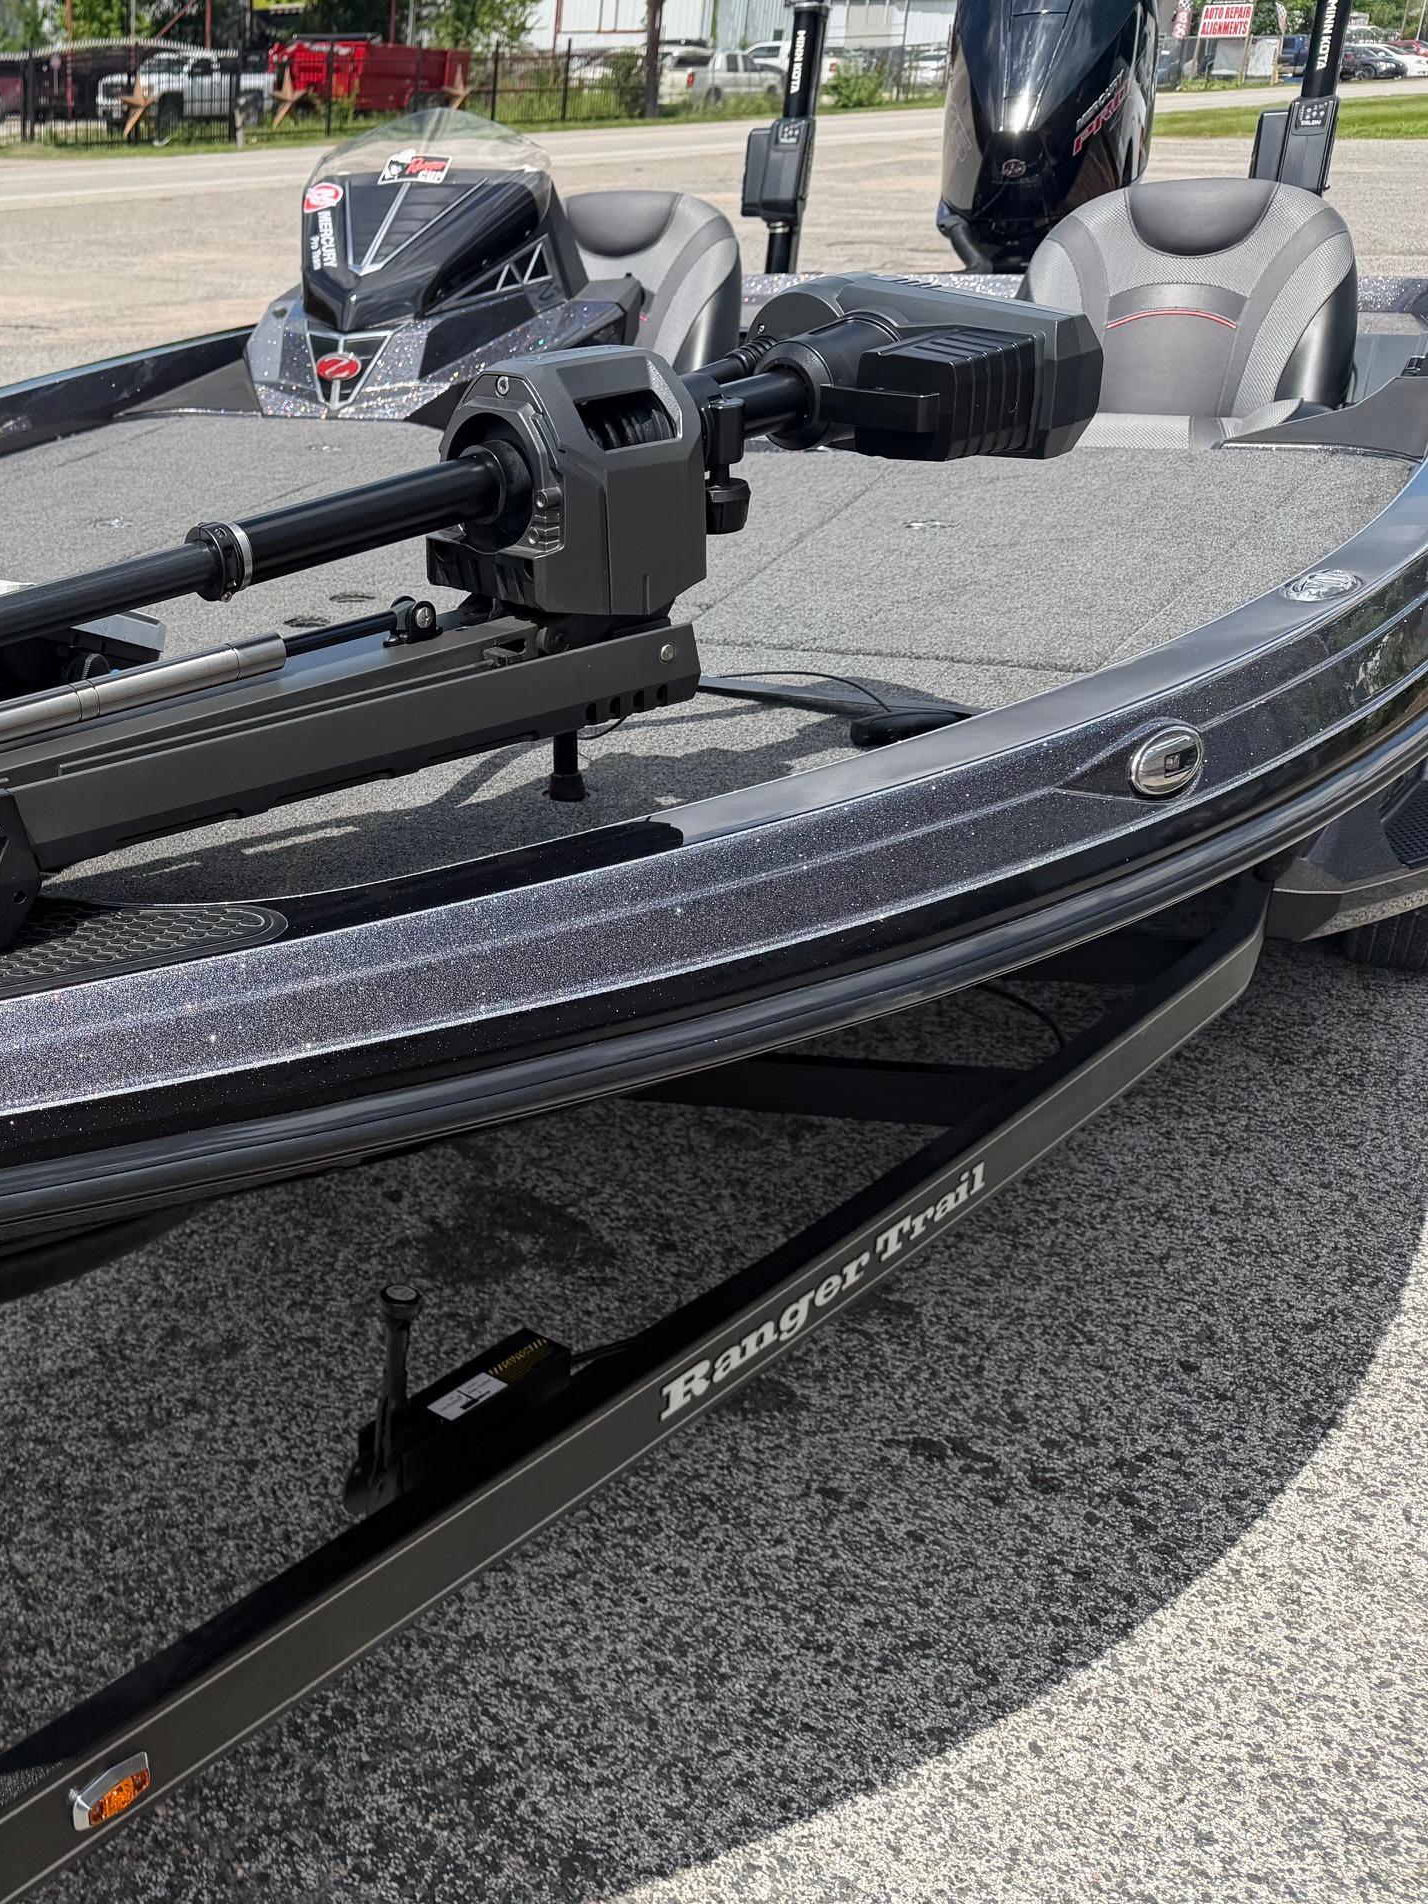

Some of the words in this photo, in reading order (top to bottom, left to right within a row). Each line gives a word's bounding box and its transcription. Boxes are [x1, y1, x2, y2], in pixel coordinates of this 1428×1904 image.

[1201, 21, 1248, 35] ALIGNMENTS
[1204, 7, 1225, 20] AUTO
[1224, 6, 1251, 19] REPAIR
[1316, 35, 1332, 70] KOTA
[790, 62, 803, 94] KOTA
[318, 210, 338, 268] MERCURY
[660, 1251, 871, 1422] Ranger
[875, 1160, 985, 1262] Trail
